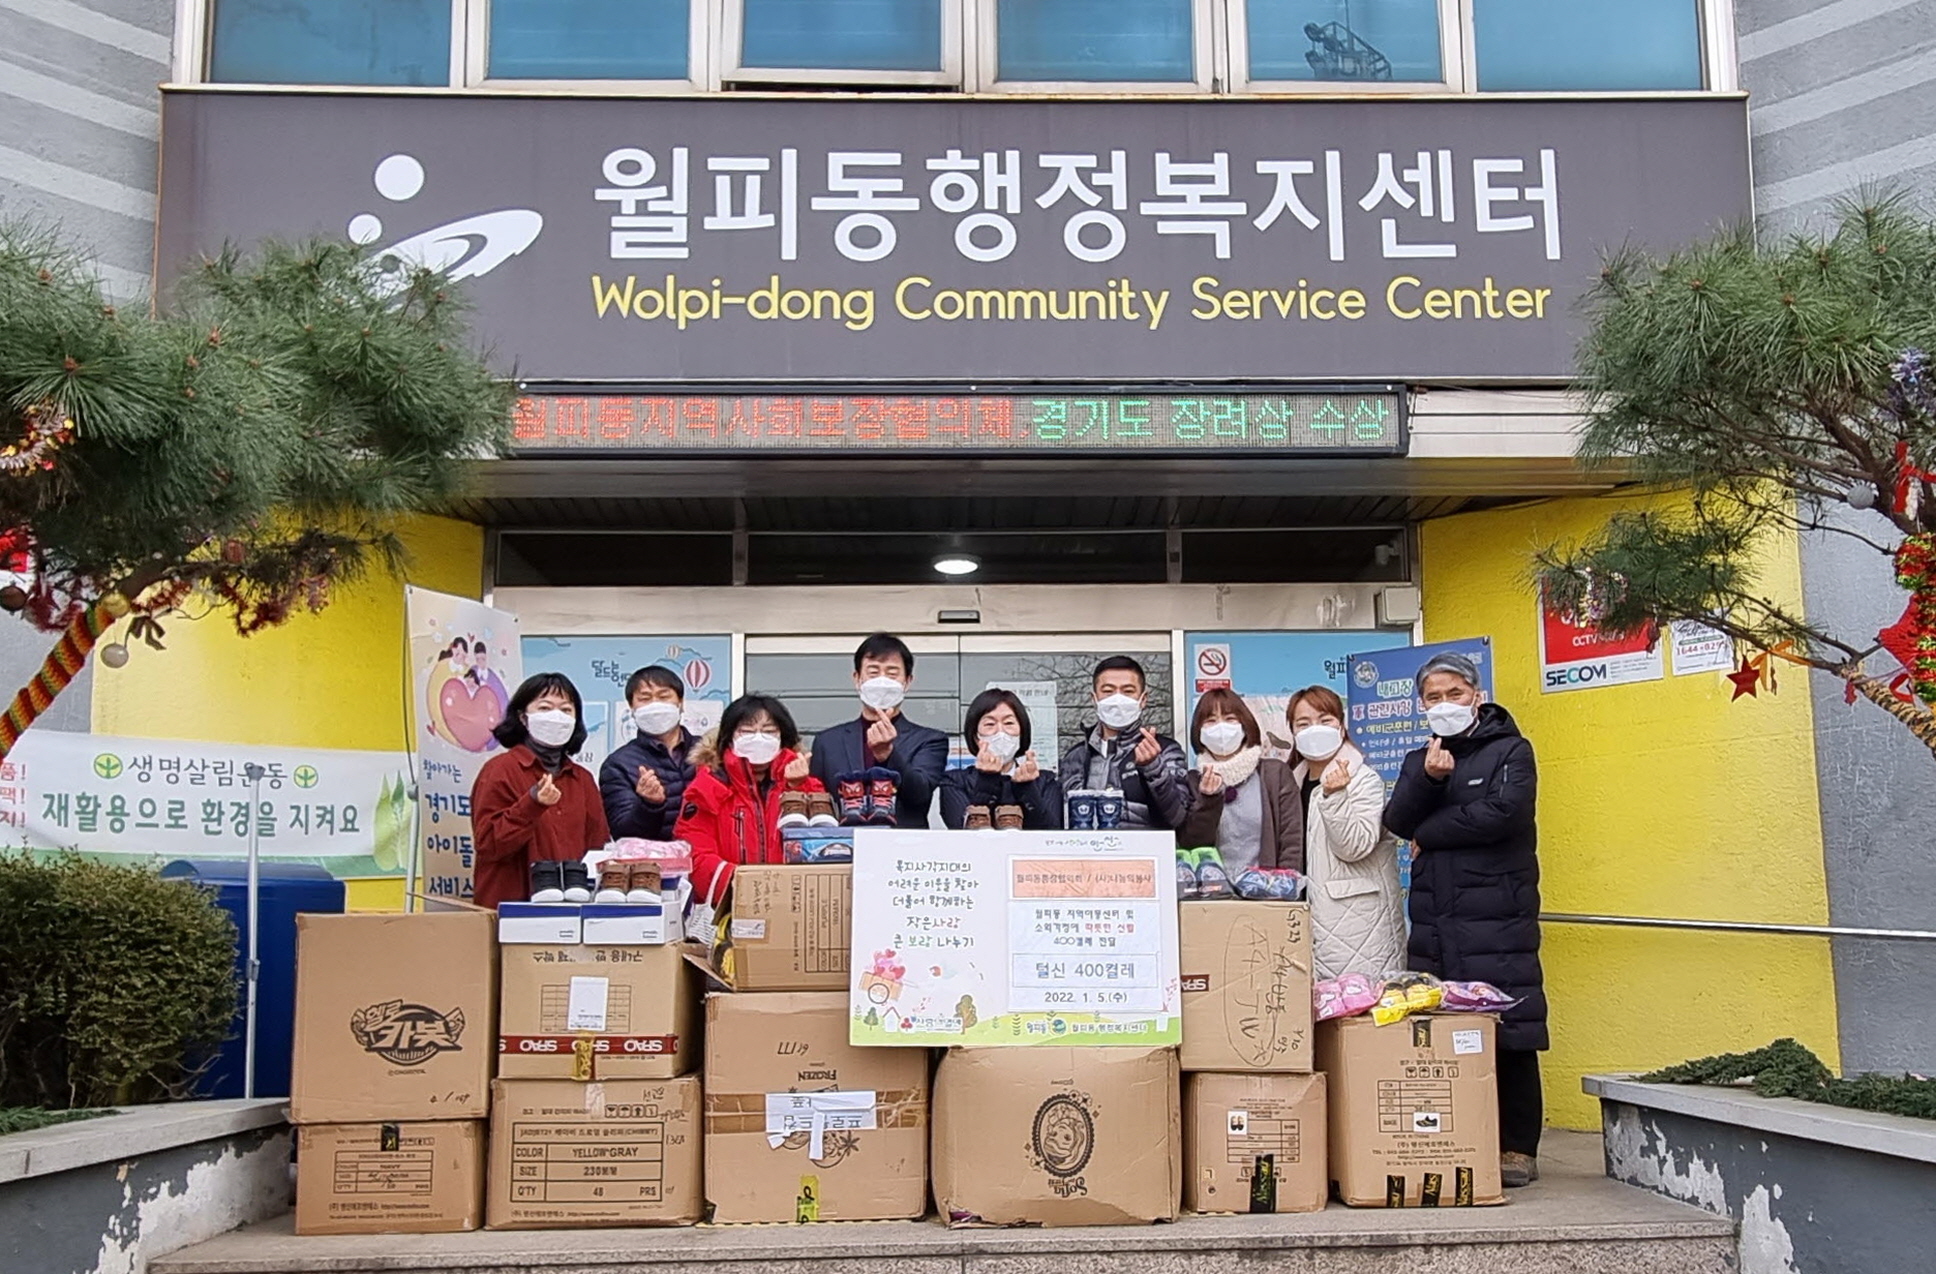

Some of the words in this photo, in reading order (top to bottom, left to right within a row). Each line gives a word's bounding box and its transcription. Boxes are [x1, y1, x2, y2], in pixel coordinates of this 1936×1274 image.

[595, 147, 1562, 263] 월피동행정복지센터
[592, 275, 875, 330] Wolpi-dong
[895, 277, 1170, 330] Community
[1191, 276, 1366, 320] Service
[1386, 276, 1551, 320] Center
[1032, 400, 1152, 440] 경기도
[1171, 399, 1294, 440] 장려상
[1310, 399, 1389, 440] 수상
[1572, 633, 1598, 647] CCTV
[1546, 663, 1607, 687] SECOM
[128, 754, 288, 790] 생명살림운동
[423, 759, 461, 784] 찾아가는
[42, 790, 189, 834] 재활용으로
[201, 798, 278, 838] 환경을
[289, 801, 361, 836] 지켜요
[425, 793, 471, 823] 경기도
[429, 876, 474, 898] 서비스
[937, 936, 974, 948] 나누기
[1036, 962, 1065, 979] 털신
[371, 1021, 455, 1049] 카봇
[519, 1039, 558, 1053] SPAO
[624, 1039, 663, 1052] SPAO
[798, 1069, 837, 1082] FROZEN
[516, 1147, 543, 1157] COLOR
[519, 1167, 538, 1176] SIZE
[640, 1186, 656, 1196] PRS
